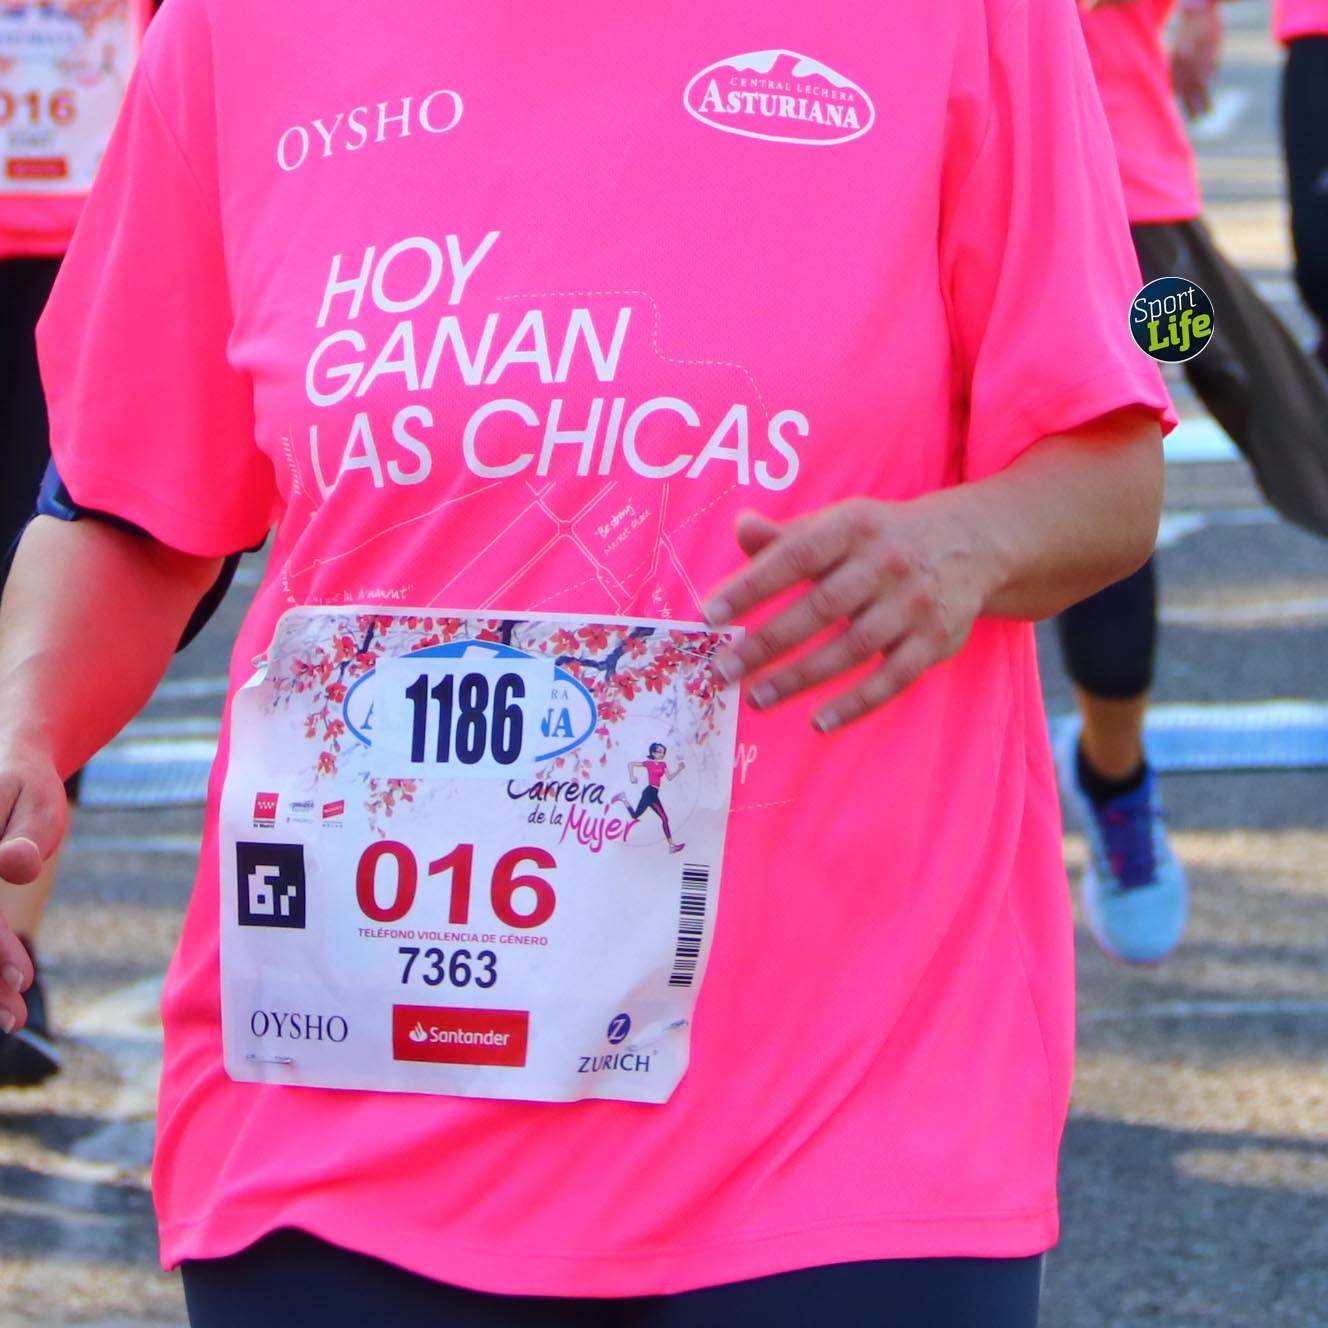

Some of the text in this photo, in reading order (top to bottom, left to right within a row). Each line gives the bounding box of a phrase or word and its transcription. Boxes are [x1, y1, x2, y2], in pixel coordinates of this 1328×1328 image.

[698, 79, 861, 129] ASTURIANA
[729, 76, 855, 103] CENTRAL LECHERA
[276, 89, 464, 171] OYSHO
[315, 230, 501, 329] HOY
[305, 307, 632, 408] GANAN
[309, 397, 810, 501] LAS CHICAS
[405, 672, 526, 765] 1186
[507, 779, 605, 804] Carrera
[528, 803, 640, 853] de la Mujer
[355, 840, 557, 929] 016
[358, 927, 549, 946] TELÉFONO VIOLENCIA DE GÉNERO
[398, 946, 498, 989] 7363
[250, 1009, 349, 1043] OYSHO
[429, 1026, 510, 1046] Santander
[578, 1051, 651, 1073] ZURICH
